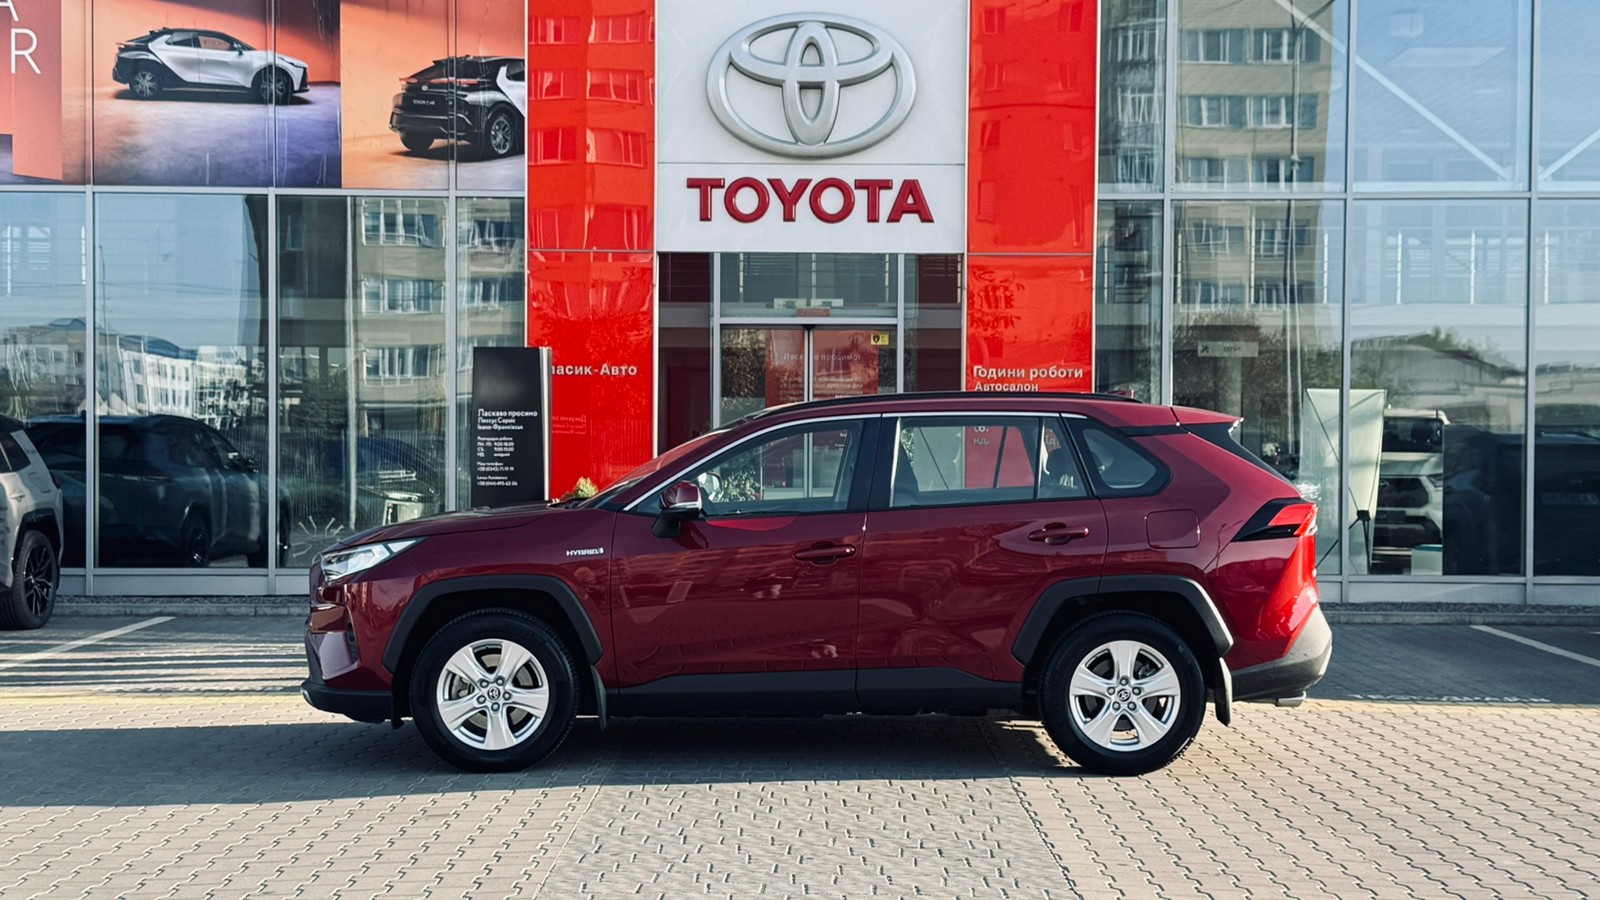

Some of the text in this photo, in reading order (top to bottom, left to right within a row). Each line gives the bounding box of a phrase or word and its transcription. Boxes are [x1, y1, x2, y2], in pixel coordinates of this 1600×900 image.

[687, 177, 935, 224] TOYOTA
[552, 363, 638, 376] асик-Авто
[973, 365, 1083, 381] Години роботи
[974, 382, 1039, 392] Автосалон
[478, 408, 538, 418] Ласкаво просимо
